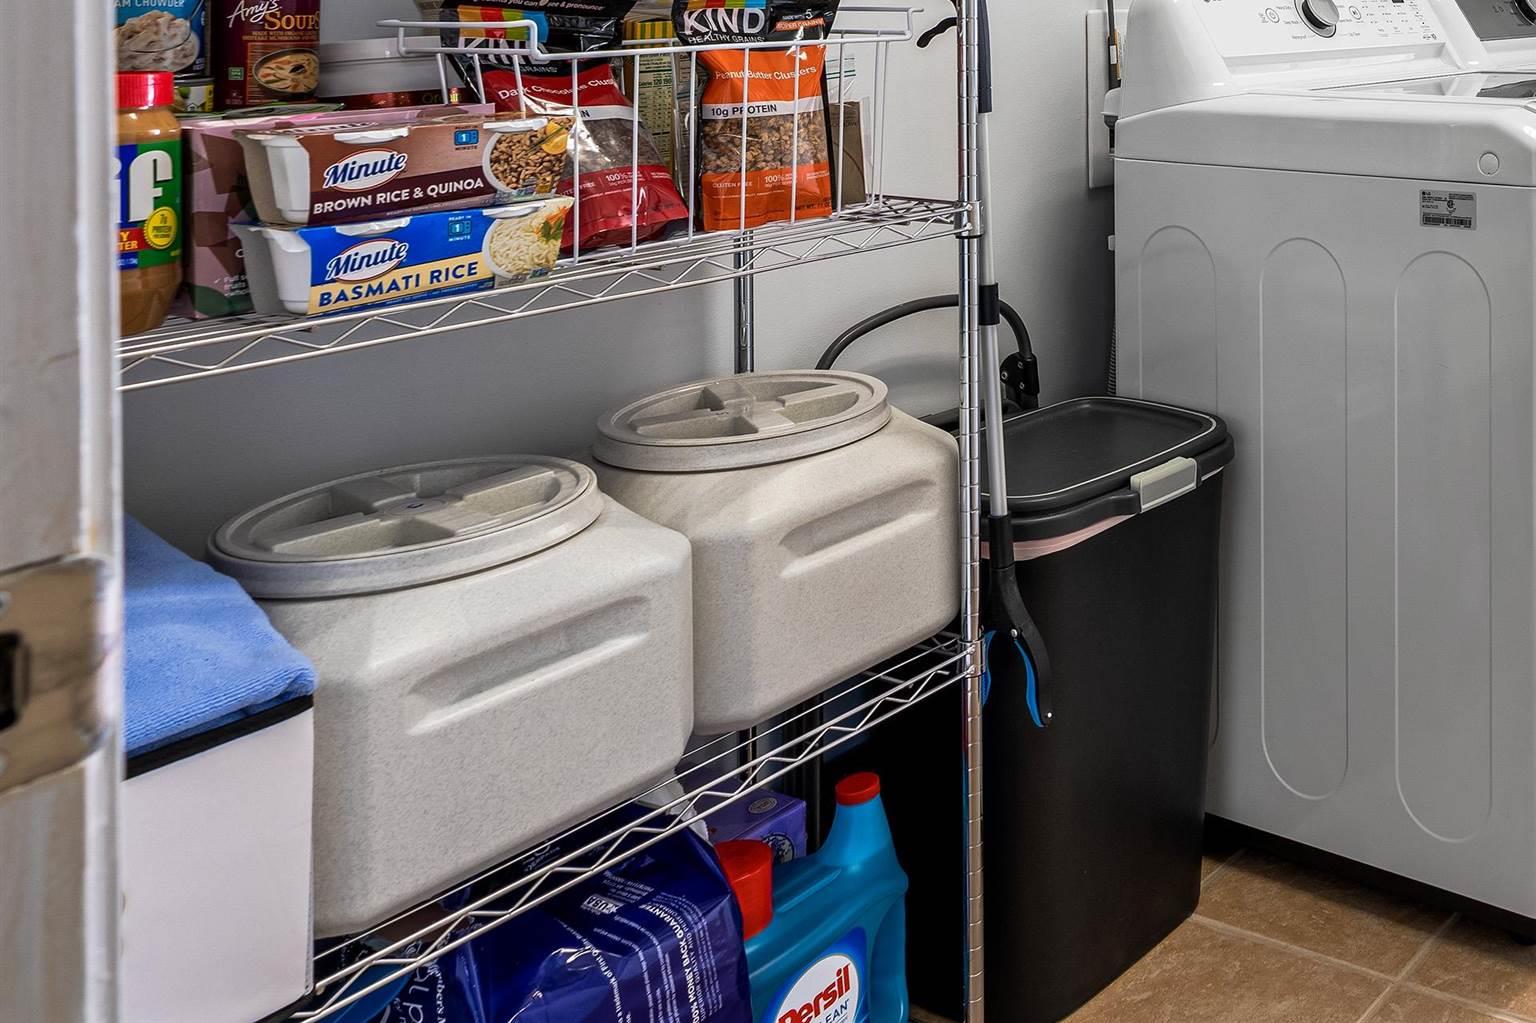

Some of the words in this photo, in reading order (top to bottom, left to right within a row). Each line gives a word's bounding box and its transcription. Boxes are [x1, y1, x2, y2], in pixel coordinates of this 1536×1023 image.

[523, 0, 538, 8] can
[682, 7, 766, 36] KIND
[688, 34, 731, 44] HEALTHY
[732, 36, 763, 44] GRAINS
[773, 65, 817, 81] Clusers
[498, 87, 529, 101] Dak
[711, 107, 729, 118] 10g
[324, 152, 407, 188] Minute
[313, 194, 373, 215] BROWN
[376, 189, 411, 206] RICE
[413, 187, 425, 199] &
[427, 177, 485, 199] QUINOA
[325, 242, 409, 280] Minute
[318, 272, 421, 307] BASMATI
[429, 261, 479, 285] RICE
[679, 938, 691, 967] BACK
[684, 966, 697, 1003] MONEY
